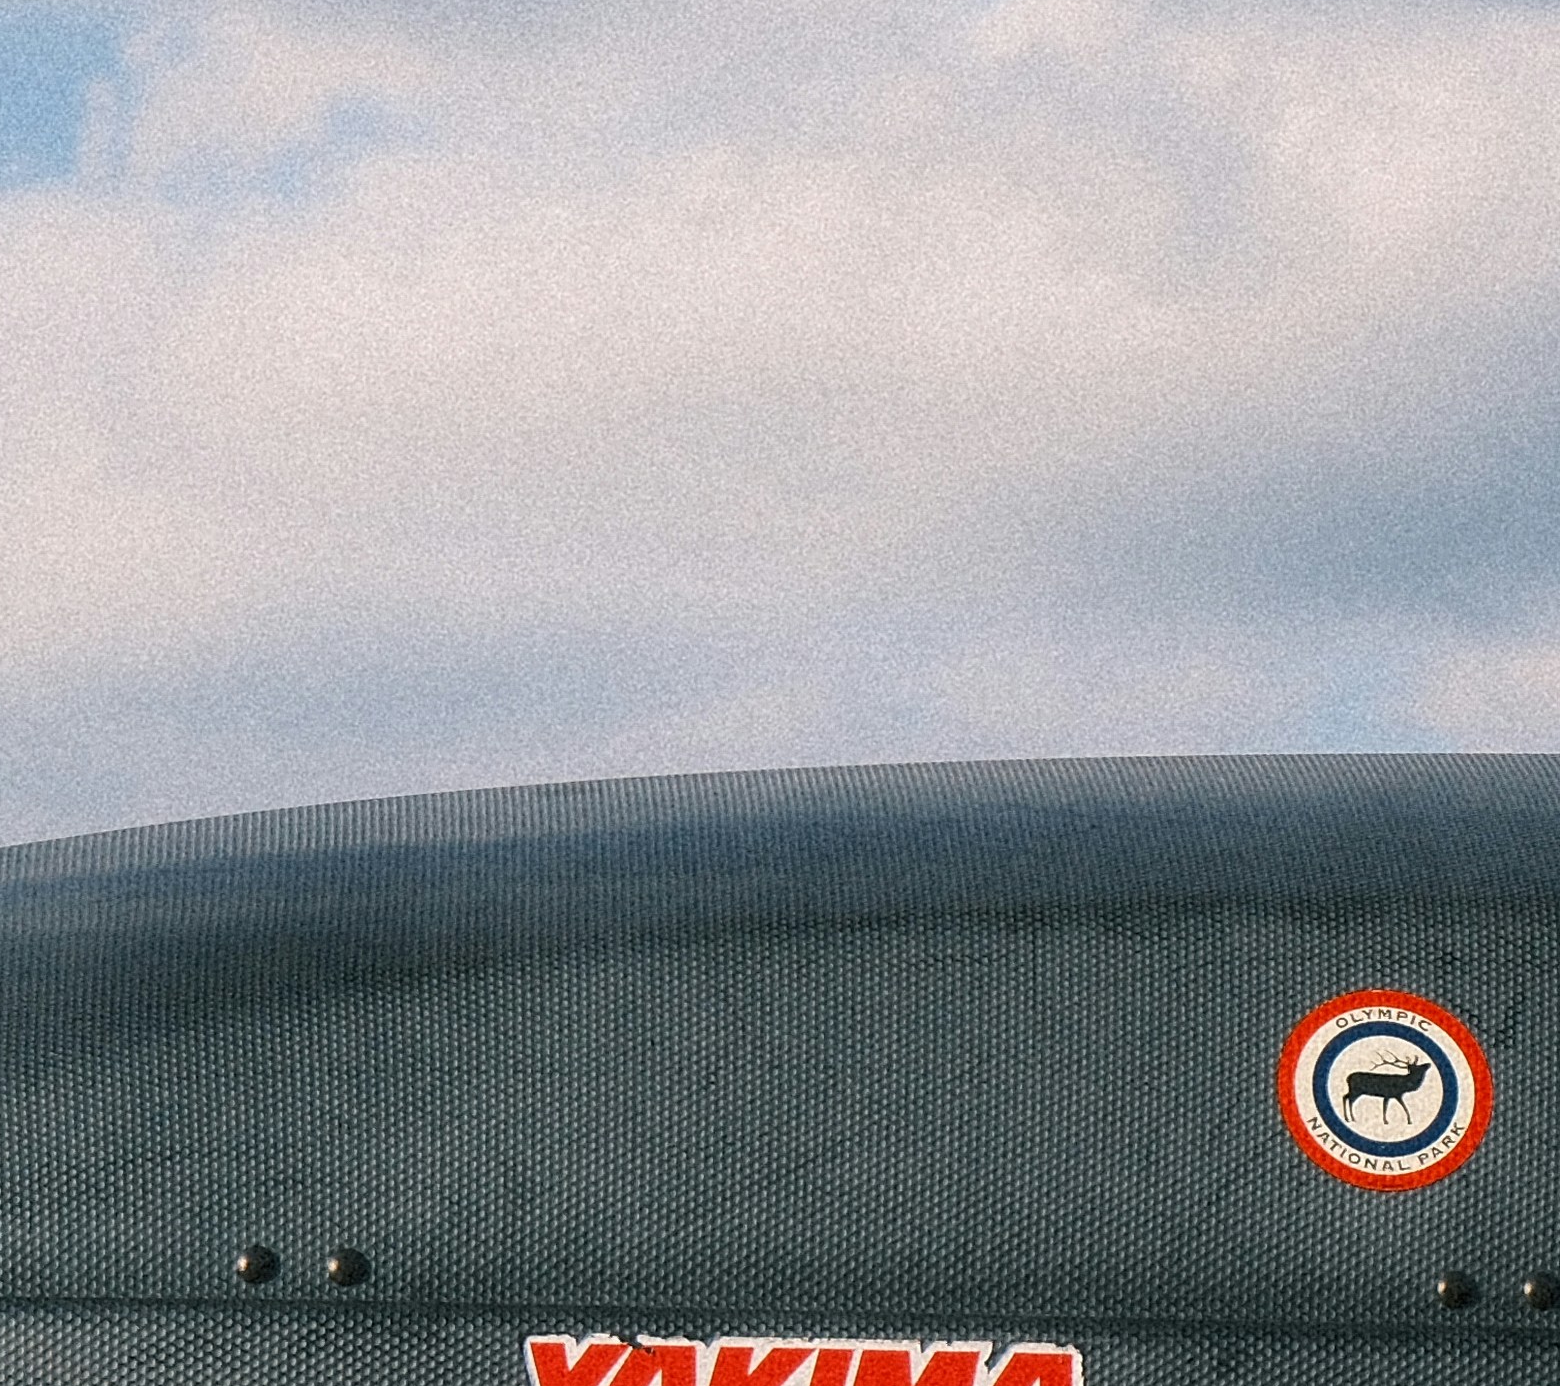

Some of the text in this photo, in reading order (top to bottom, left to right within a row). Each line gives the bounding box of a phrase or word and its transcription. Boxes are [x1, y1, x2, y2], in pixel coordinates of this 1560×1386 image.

[1336, 1009, 1433, 1032] OLYMPIC
[1307, 1116, 1465, 1172] NATIONAL PARK
